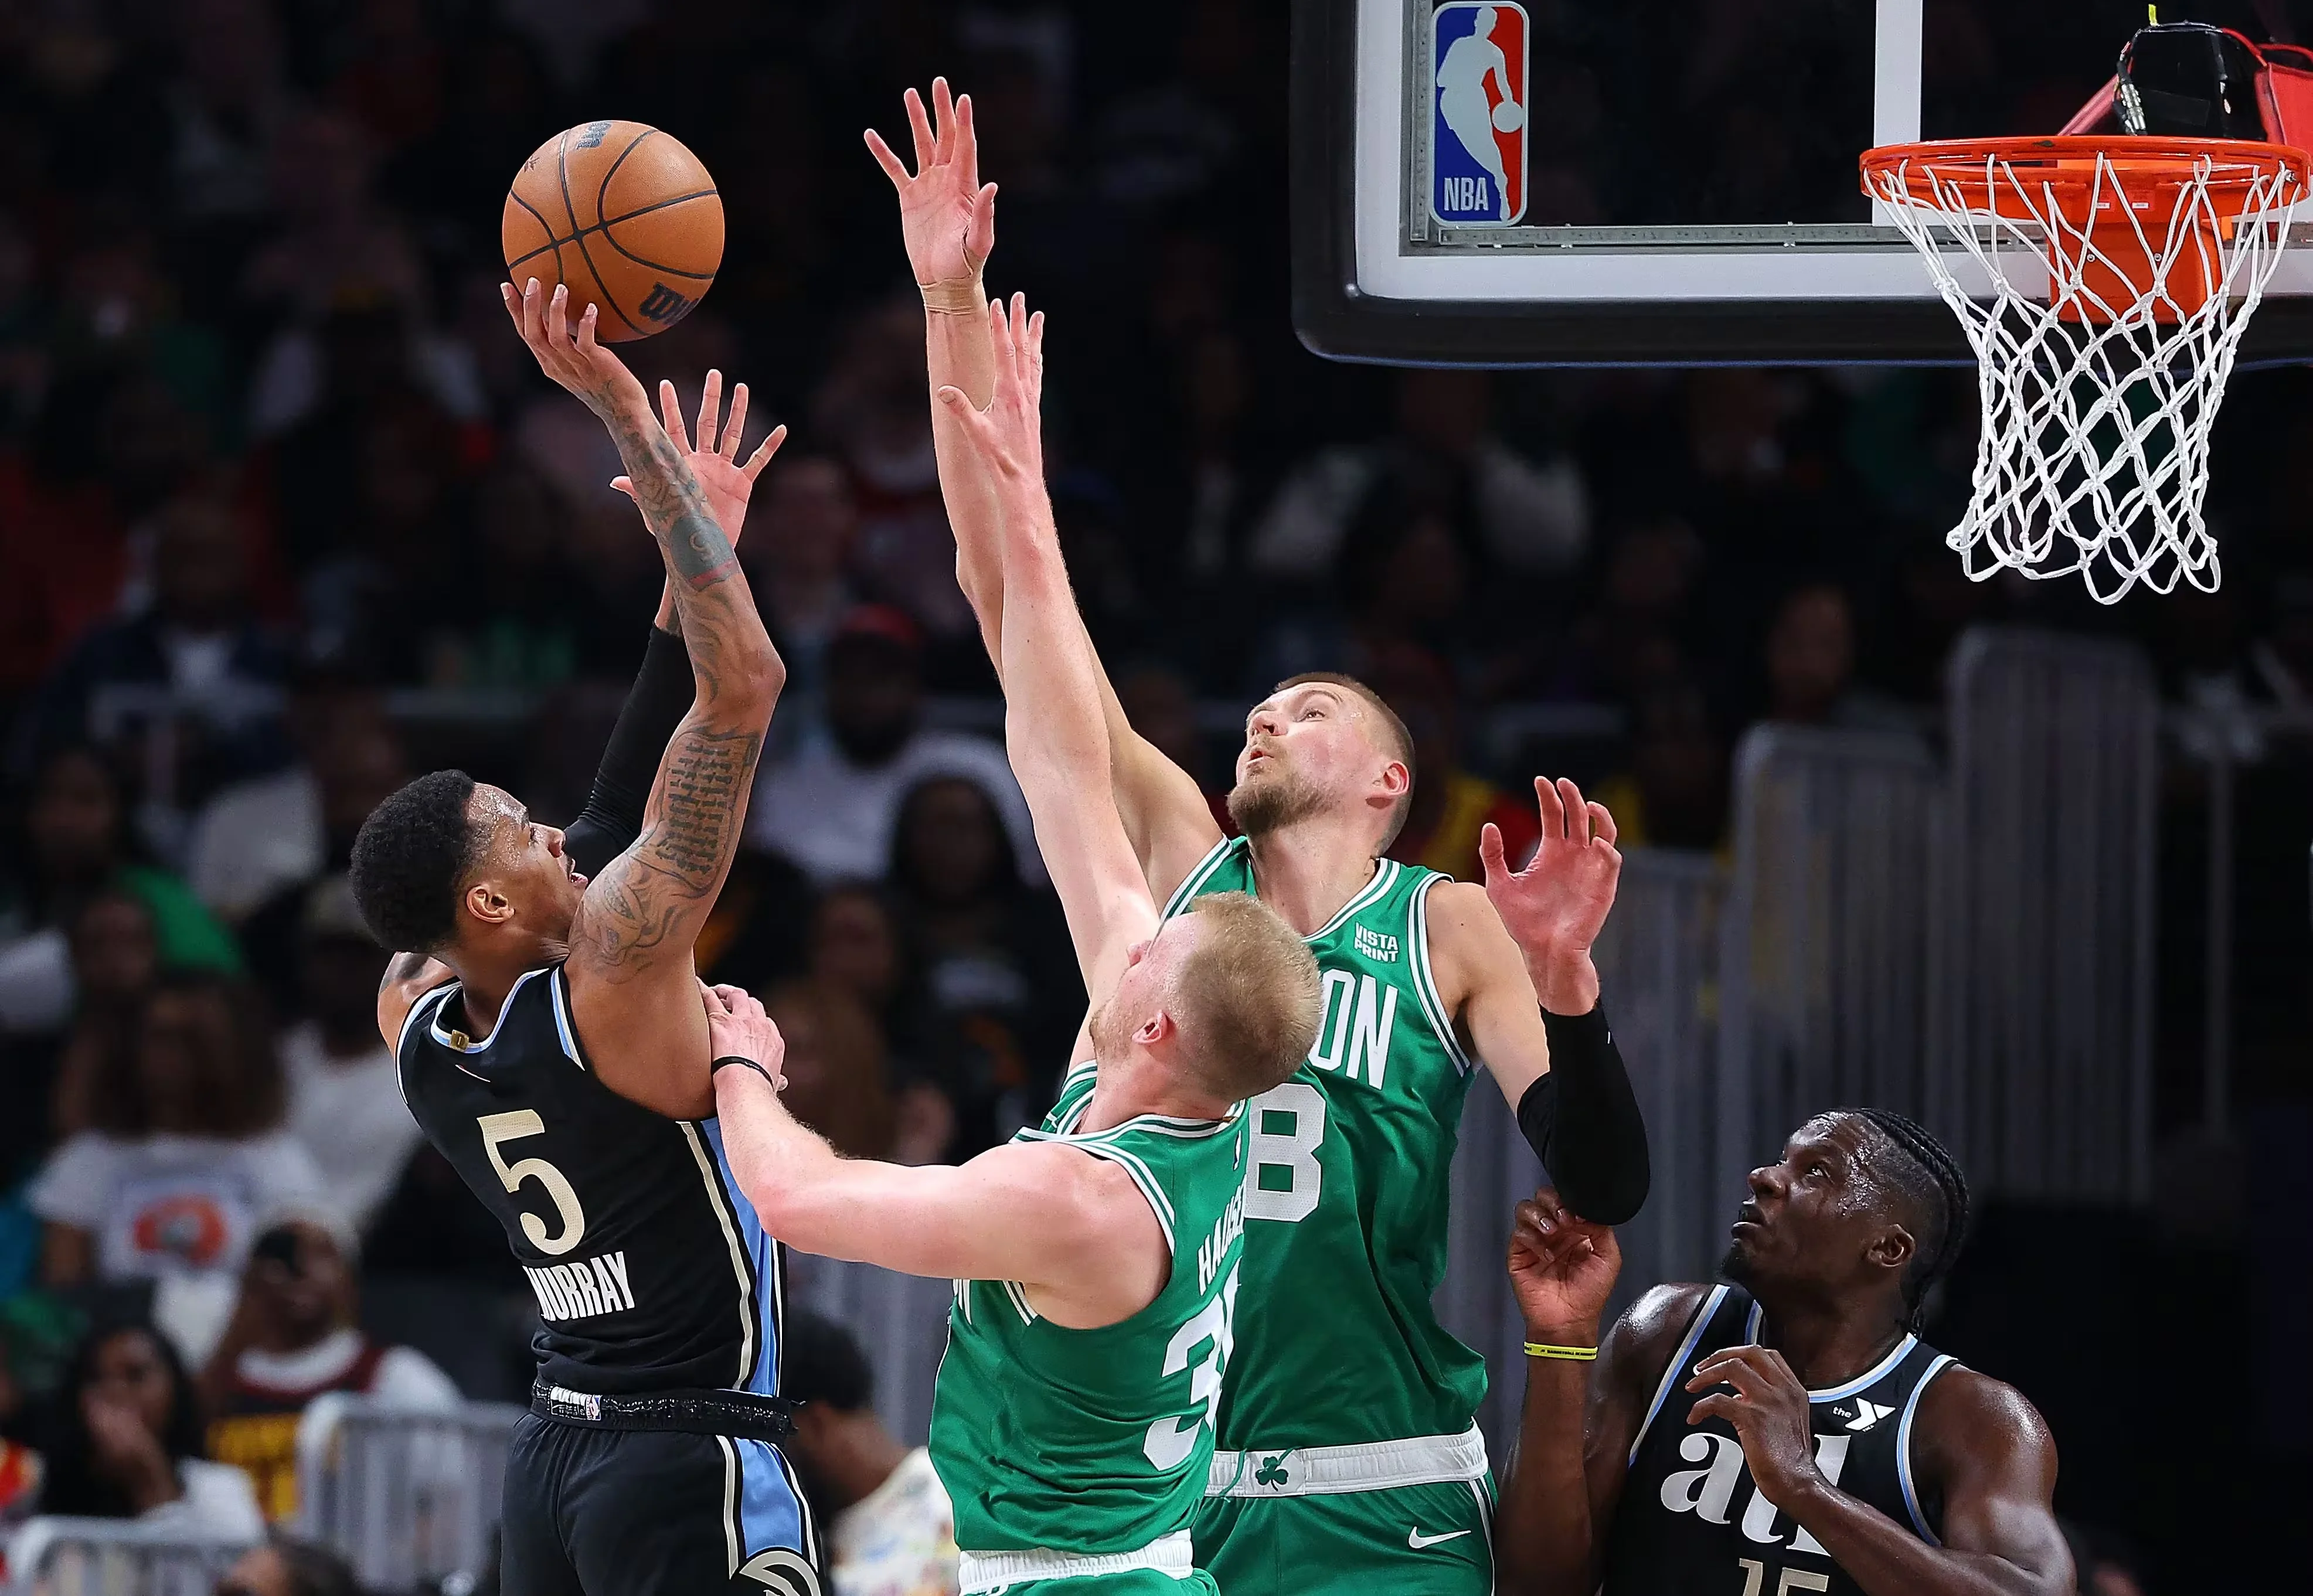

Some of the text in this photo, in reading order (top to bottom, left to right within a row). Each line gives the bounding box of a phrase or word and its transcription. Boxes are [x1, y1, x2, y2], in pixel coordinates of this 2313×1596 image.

[1444, 177, 1489, 211] NBA
[1353, 936, 1399, 962] PRINT
[1355, 921, 1399, 951] VISTA
[477, 1109, 585, 1255] 5
[1832, 1406, 1852, 1418] the
